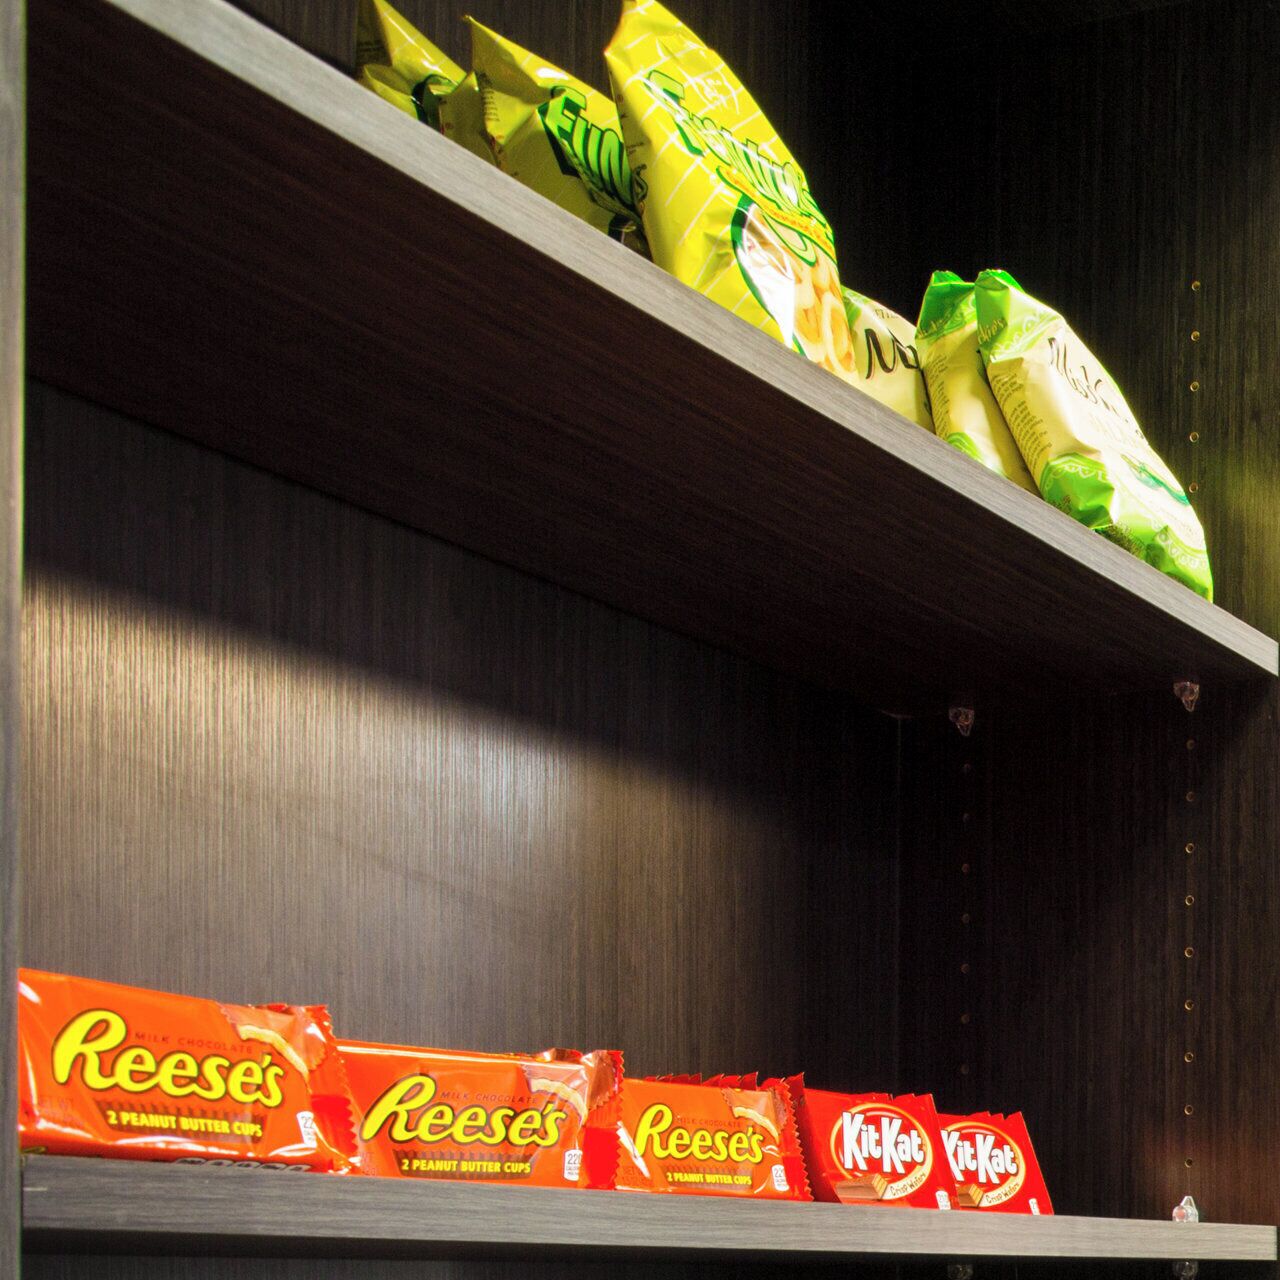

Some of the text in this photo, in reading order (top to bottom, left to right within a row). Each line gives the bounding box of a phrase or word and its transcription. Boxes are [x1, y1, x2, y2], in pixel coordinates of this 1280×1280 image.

[134, 1031, 171, 1045] MILK
[52, 1008, 285, 1108] Reese's
[106, 1110, 263, 1138] 2 PEANUT BUTTER CUPS
[359, 1073, 568, 1148] Reese's
[633, 1103, 764, 1165] Reese's
[401, 1158, 531, 1174] 2 PEANUT BUTTER CUPS
[666, 1172, 753, 1186] 2 PEANUT BUTTER CUPS
